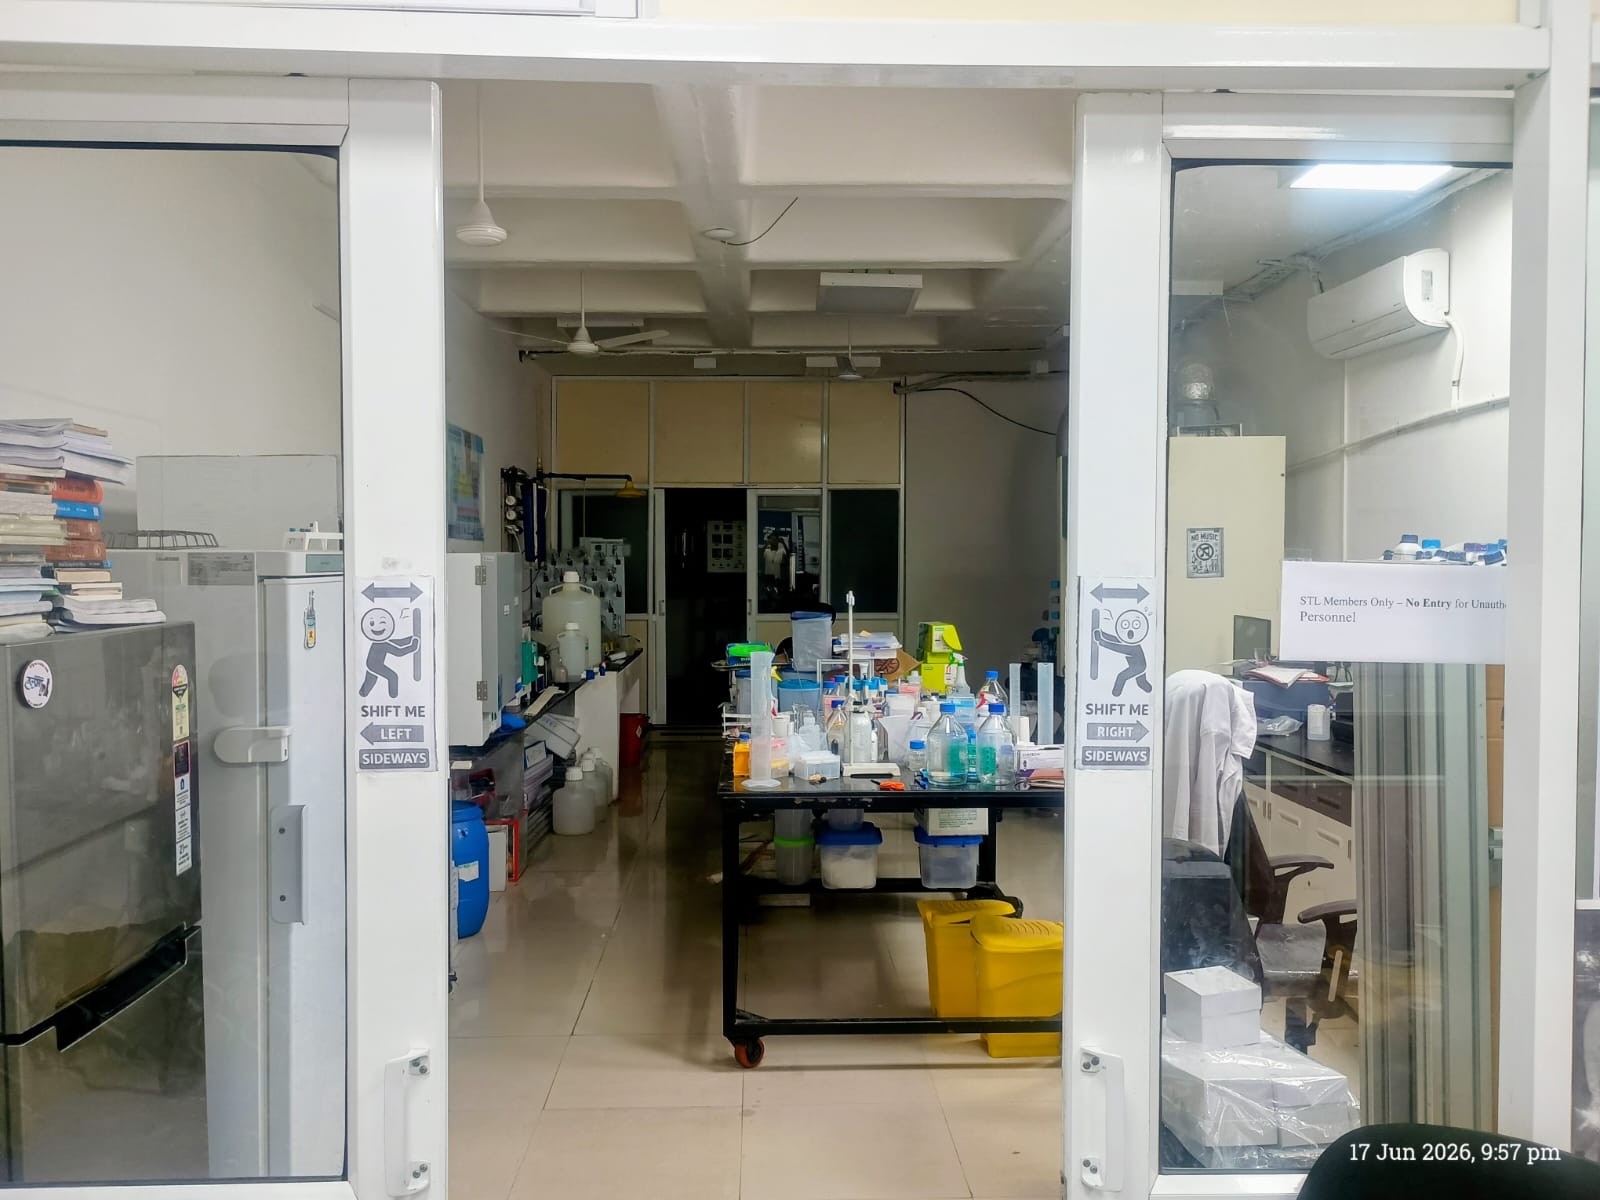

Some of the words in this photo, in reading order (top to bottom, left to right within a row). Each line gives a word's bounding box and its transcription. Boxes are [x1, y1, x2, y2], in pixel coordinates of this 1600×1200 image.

[1200, 533, 1219, 542] MUSIC
[1299, 595, 1321, 606] STL
[1323, 596, 1368, 608] Members
[1370, 597, 1394, 609] Only
[1405, 598, 1420, 608] No
[1423, 598, 1452, 610] Entry
[1454, 598, 1469, 609] for
[1299, 611, 1356, 623] Personnel
[360, 704, 401, 718] SHIFT
[404, 704, 426, 718] ME
[1085, 703, 1126, 716] SHIFT
[1129, 704, 1150, 716] ME
[380, 727, 413, 740] LEFT
[1096, 726, 1134, 738] RIGHT
[361, 752, 427, 765] SIDEWAYS
[1084, 748, 1148, 762] SIDEWAYS
